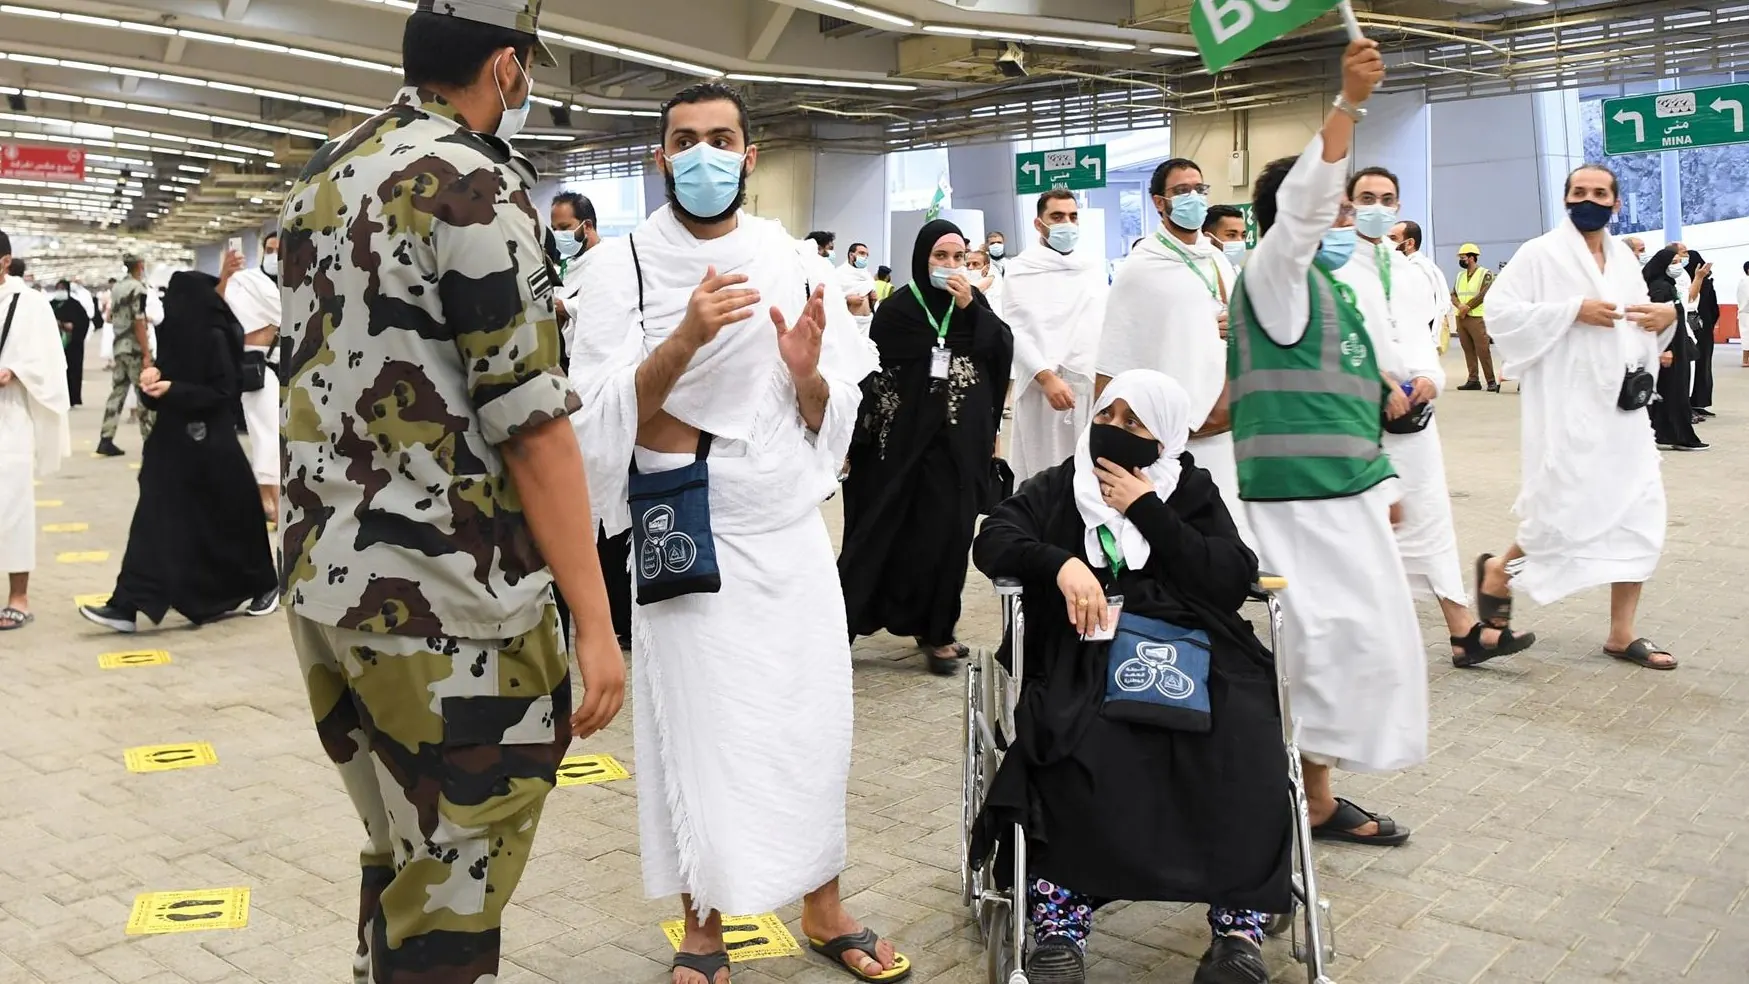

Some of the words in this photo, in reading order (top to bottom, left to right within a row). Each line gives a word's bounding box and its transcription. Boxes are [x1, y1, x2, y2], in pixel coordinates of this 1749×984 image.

[1664, 120, 1689, 134] منى
[1662, 135, 1693, 146] MINA
[1050, 171, 1070, 182] منى
[1051, 182, 1069, 190] MINA
[1245, 230, 1254, 246] 4
